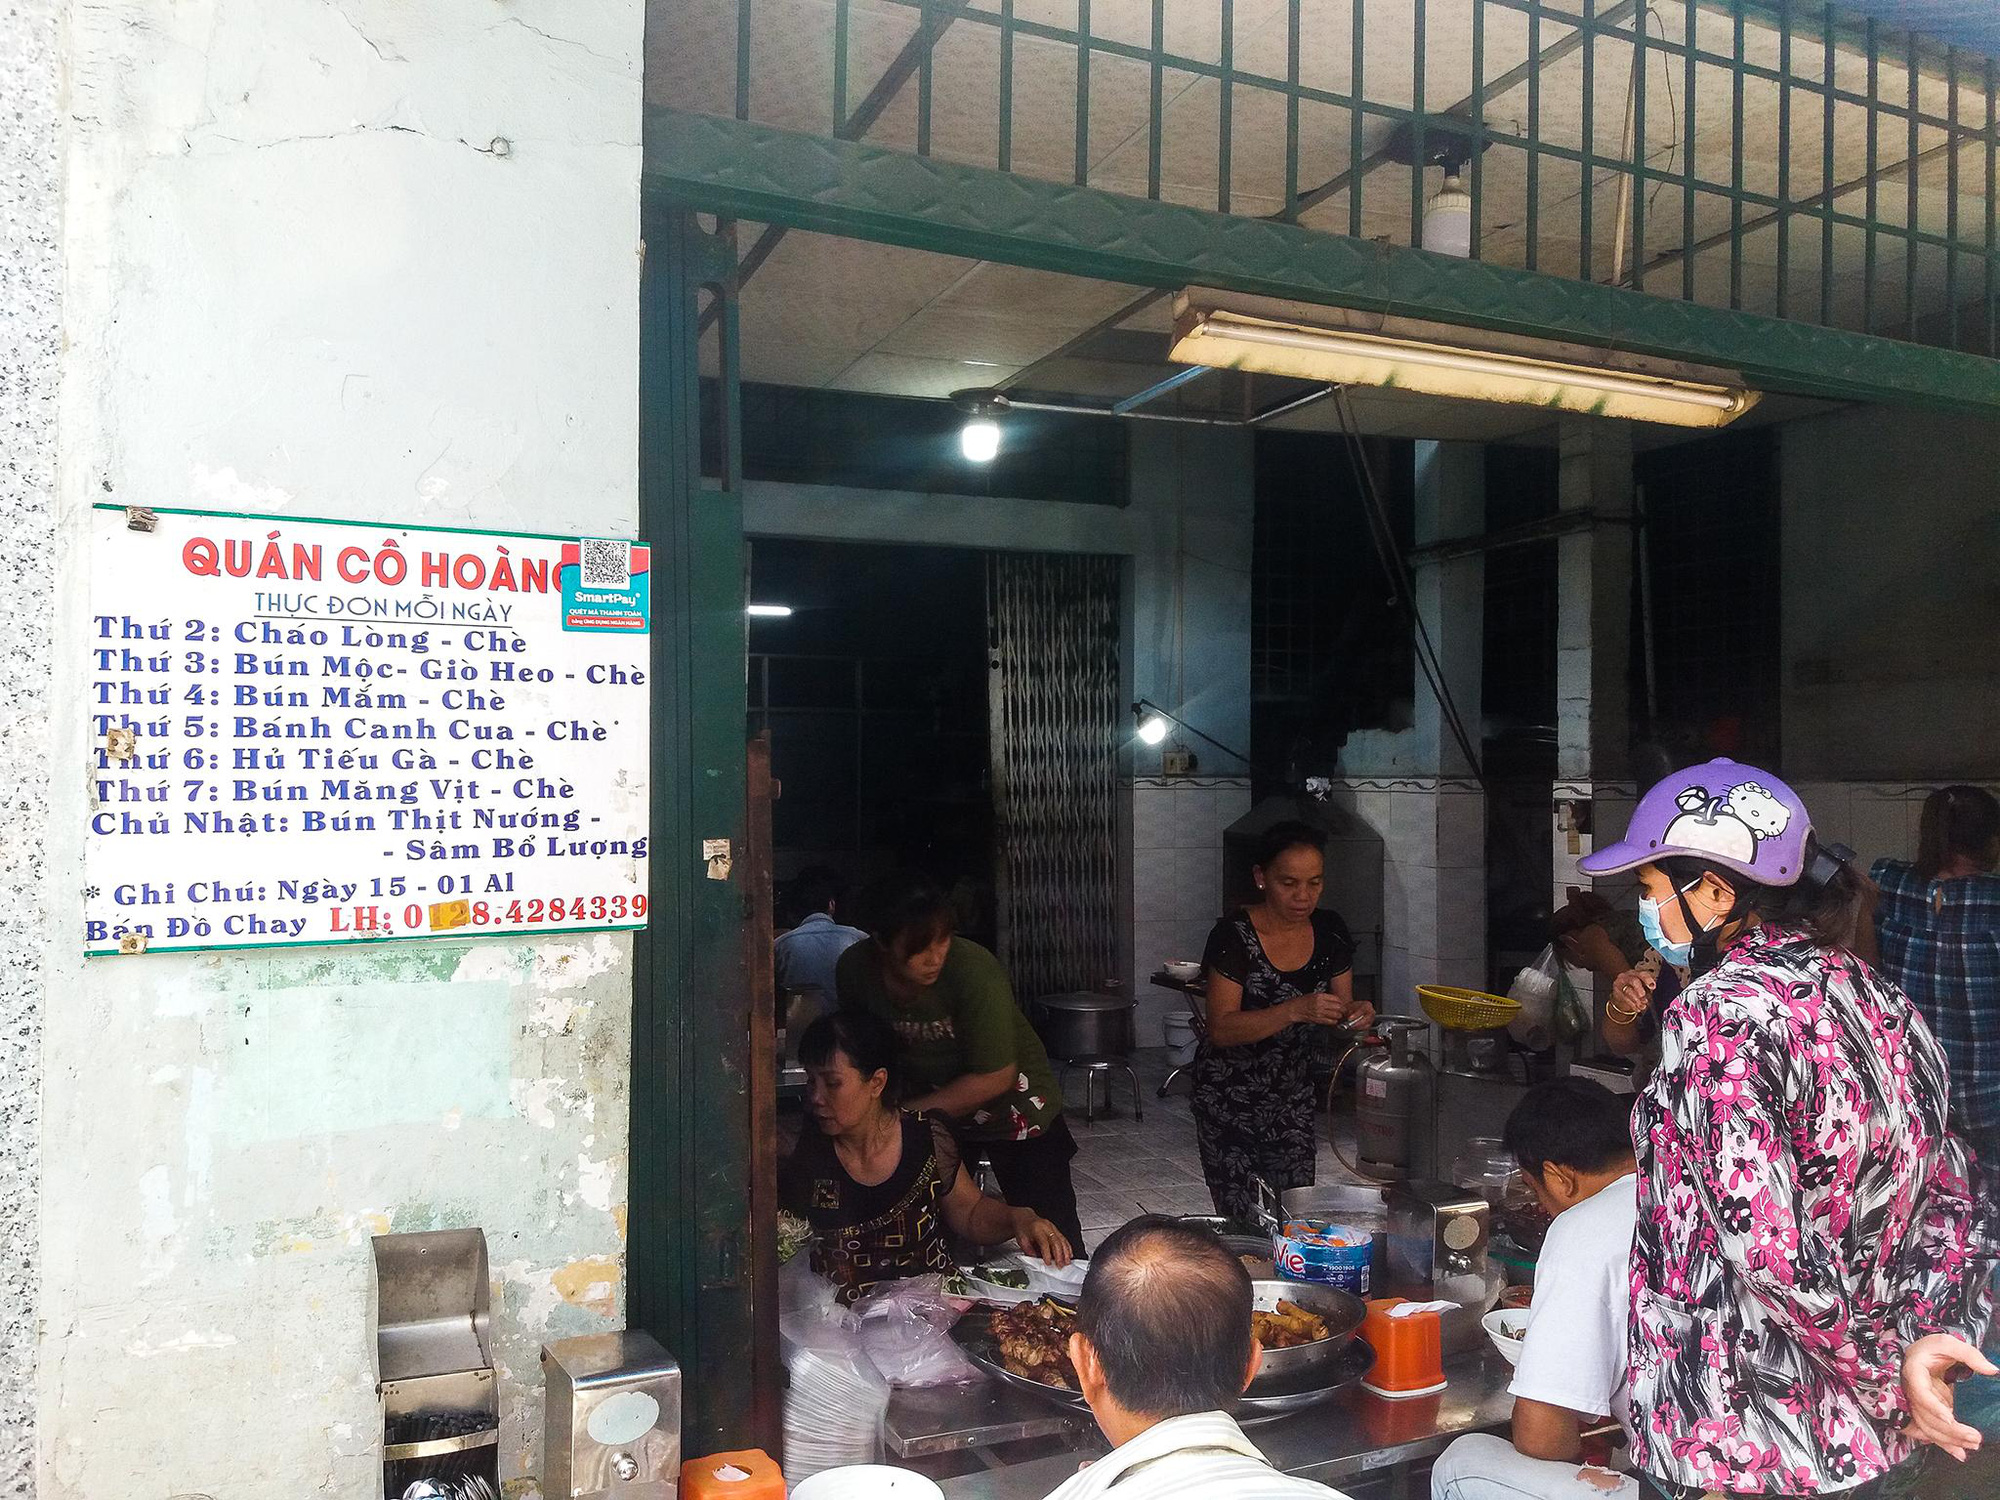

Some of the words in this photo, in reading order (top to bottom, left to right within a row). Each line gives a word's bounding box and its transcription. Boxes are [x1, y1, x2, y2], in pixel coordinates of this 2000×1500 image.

[183, 531, 322, 581] QUÁN
[337, 539, 407, 585] CÔ
[254, 593, 318, 616] THỰC
[327, 595, 387, 618] ĐƠN
[396, 594, 443, 619] MỖI
[453, 598, 512, 622] NGÀY
[574, 591, 636, 607] SmartPay
[94, 616, 172, 640] Thứ
[185, 620, 219, 642] 2:
[235, 622, 327, 645] Cháo
[342, 625, 429, 653] Lòng
[464, 631, 526, 652] Chè
[94, 649, 172, 672] Thứ
[185, 652, 219, 673] 3:
[234, 653, 309, 675] Bún
[421, 659, 477, 680] Giò
[490, 662, 553, 682] Heo
[587, 665, 644, 685] Chè
[93, 681, 171, 704] Thứ
[184, 684, 218, 705] 4:
[234, 685, 309, 706] Bún
[322, 684, 406, 708] Mắm
[442, 689, 504, 710] Chè
[93, 714, 171, 737] Thứ
[184, 716, 218, 737] 5:
[234, 717, 331, 738] Bánh
[345, 718, 436, 739] Canh
[449, 720, 514, 740] Cua
[547, 721, 606, 741] Chè
[184, 748, 217, 769] 6:
[233, 748, 285, 769] Hủ
[299, 748, 378, 769] Tiếu
[392, 749, 436, 769] Gà
[472, 749, 533, 769] Chè
[95, 780, 170, 802] Thứ
[184, 780, 217, 801] 7:
[233, 780, 308, 801] Bún
[321, 780, 418, 804] Măng
[430, 779, 479, 803] Vịt
[514, 778, 573, 798] Chè
[92, 812, 169, 835] Chủ
[184, 811, 287, 837] Nhật:
[303, 810, 375, 831] Bún
[388, 809, 461, 833] Thịt
[473, 807, 580, 831] Nướng
[407, 840, 480, 860] Sâm
[493, 835, 535, 857] Bổ
[547, 837, 647, 859] Lượng
[114, 883, 174, 905] Ghi
[188, 881, 265, 903] Chú:
[278, 879, 356, 903] Ngày
[371, 876, 405, 897] 15
[438, 875, 472, 894] 01
[86, 918, 154, 941] Bán
[167, 916, 211, 937] Đồ
[224, 914, 306, 937] Chay
[329, 906, 392, 931] LH:
